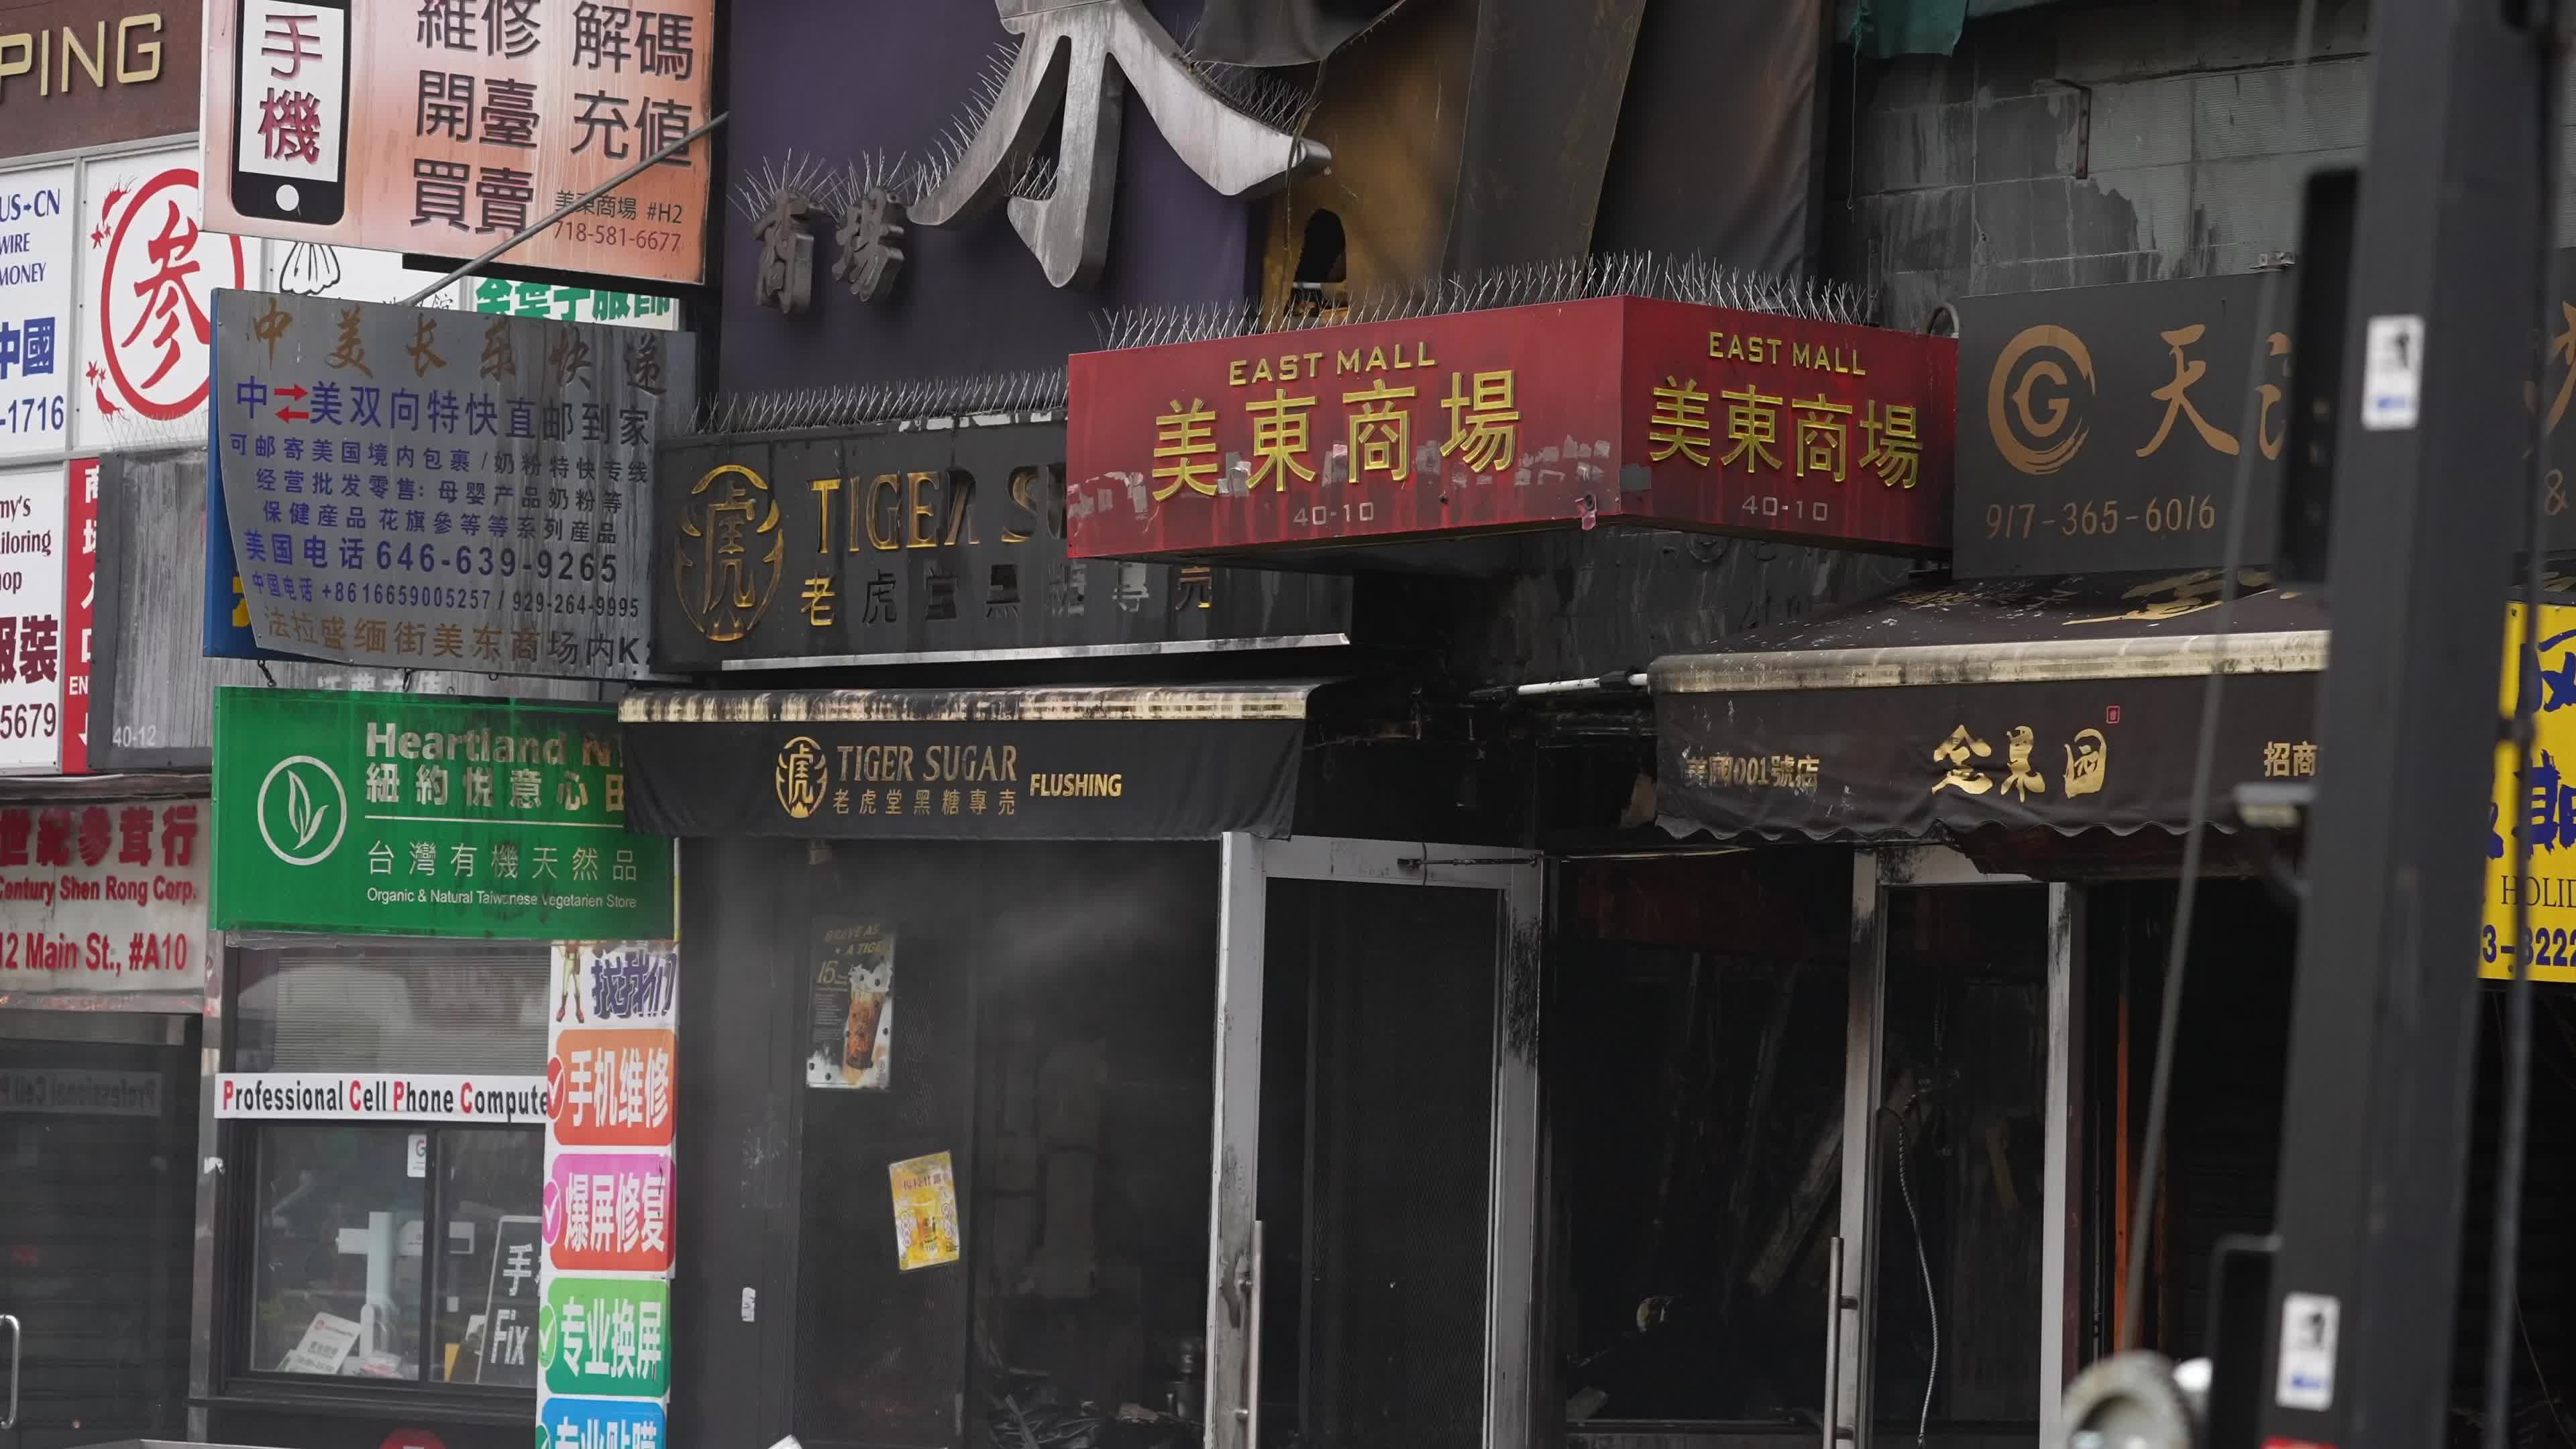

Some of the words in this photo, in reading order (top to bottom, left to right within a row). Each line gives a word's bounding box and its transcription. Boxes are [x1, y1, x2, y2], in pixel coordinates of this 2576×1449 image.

[572, 0, 694, 81] 解碼
[258, 13, 323, 164] 手機
[416, 70, 540, 150] 開臺
[571, 90, 692, 167] 充值
[410, 158, 534, 236] 買賣
[647, 202, 683, 224] #H2
[554, 220, 682, 252] 718-581-6677
[1229, 352, 1324, 386] EAST
[1337, 342, 1438, 374] MALL
[1709, 331, 1782, 365] EAST
[1792, 342, 1867, 376] MALL
[237, 376, 267, 419] 中
[1152, 369, 1521, 502] 美東商場
[1649, 374, 1923, 490] 美東商場
[1293, 502, 1375, 525] 40-10
[1741, 495, 1829, 523] 40-10
[1986, 494, 2215, 539] 917-365-6016
[244, 529, 366, 569] 美国电话
[376, 541, 616, 583] 646-639-9265
[513, 591, 639, 618] 929-264-9995
[112, 725, 156, 747] 40-12
[366, 722, 567, 765] Heartland
[837, 745, 914, 782] TIGER
[923, 745, 1018, 782] SUGAR
[1030, 773, 1122, 797] FLUSHING
[368, 839, 637, 881] 台灣有機天然品
[60, 875, 100, 901] Shen
[106, 875, 148, 906] Rong
[153, 875, 197, 906] Corp.
[367, 888, 414, 905] Organic
[418, 889, 427, 903] &
[431, 889, 472, 904] Natural
[606, 894, 637, 908] Store
[25, 932, 78, 970] Main
[129, 932, 188, 971] #A10
[223, 1080, 343, 1112] Professional
[349, 1081, 387, 1112] Cell
[393, 1081, 454, 1114] Phone
[568, 1046, 669, 1128] 手机维修
[564, 1171, 665, 1253] 爆屏修复
[561, 1295, 662, 1382] 专业换屏
